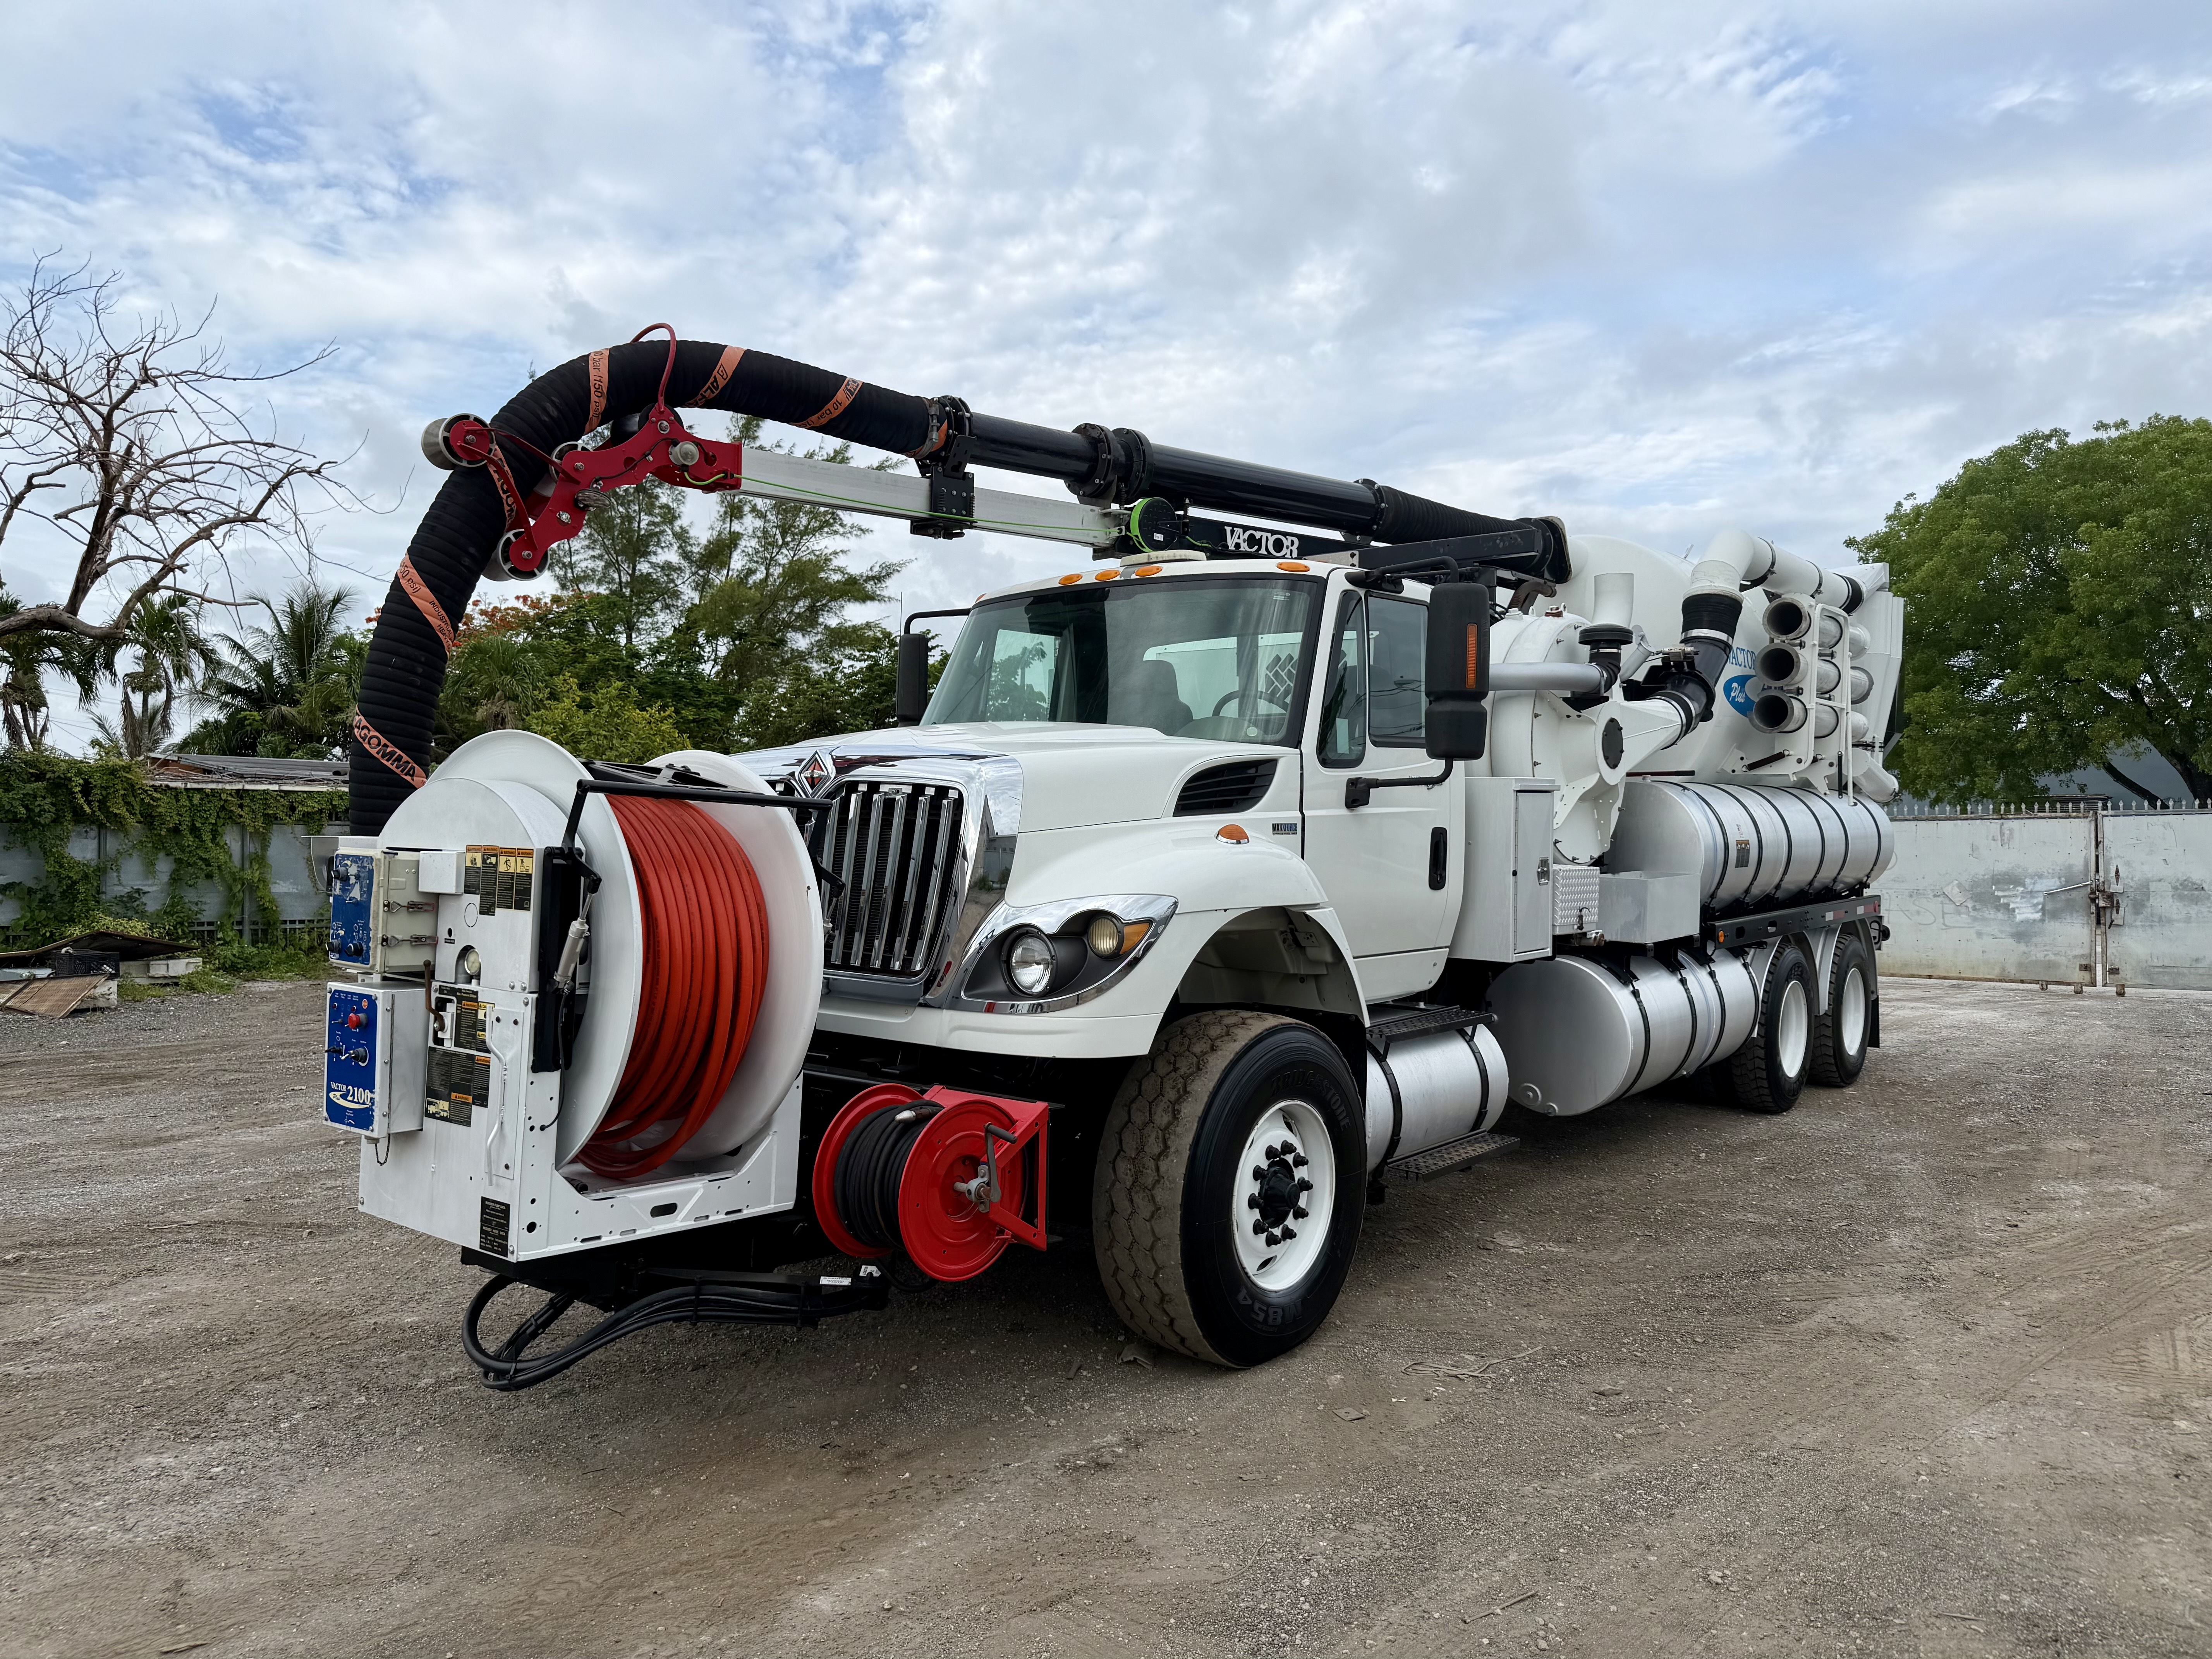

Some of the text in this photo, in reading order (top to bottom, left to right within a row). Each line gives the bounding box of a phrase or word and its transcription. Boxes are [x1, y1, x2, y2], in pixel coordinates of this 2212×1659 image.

[592, 357, 603, 372] bar
[817, 408, 833, 420] bar
[833, 399, 843, 410] 10
[1224, 526, 1299, 558] VACTOR
[405, 577, 422, 594] psi)
[429, 600, 453, 636] INDUSTRIAL
[1729, 682, 1746, 703] Plus
[331, 1082, 347, 1092] VACTOR
[347, 1085, 370, 1104] 2100
[1271, 1069, 1351, 1131] BRIDGESTONE
[1236, 1286, 1303, 1326] M854
